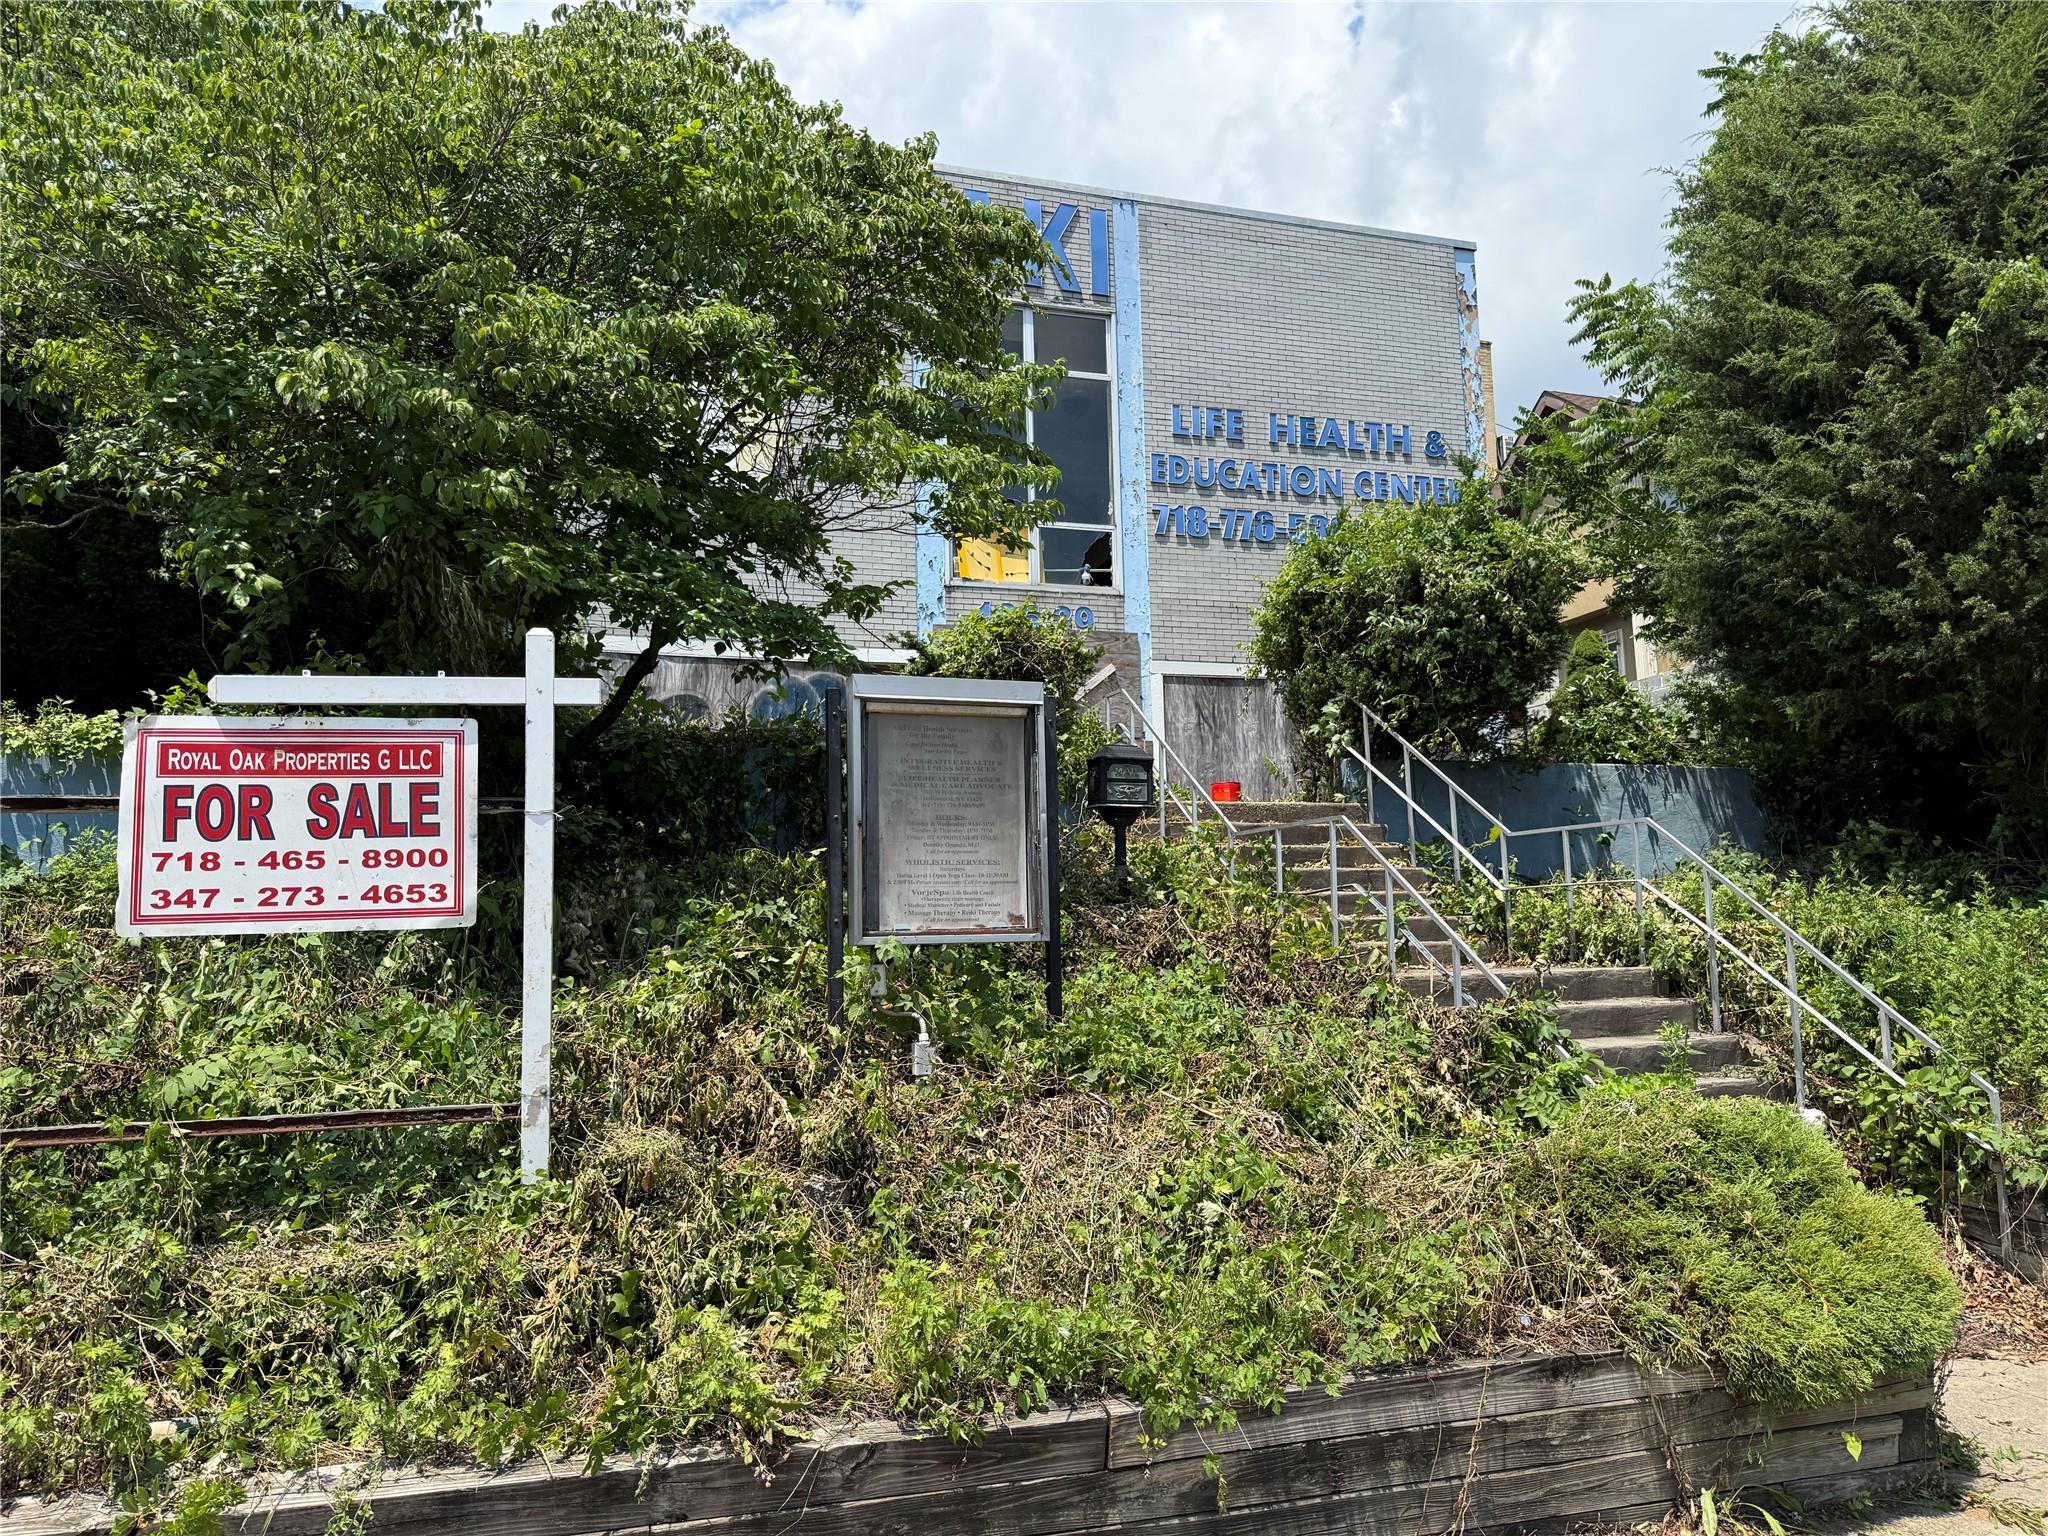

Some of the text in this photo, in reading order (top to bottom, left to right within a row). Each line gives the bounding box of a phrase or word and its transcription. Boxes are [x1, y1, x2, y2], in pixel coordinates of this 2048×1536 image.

[962, 189, 1110, 296] KI
[1171, 404, 1447, 459] LIFE HEALTH &
[1151, 453, 1343, 498] EDUCATION
[168, 749, 432, 770] ROYAL OAK PROPERTIES G LLC
[162, 782, 440, 842] FOR SALE
[152, 852, 221, 872] 718
[257, 850, 326, 870] 465
[361, 849, 448, 868] 8900
[904, 858, 954, 866] WHOLISTIC
[150, 888, 220, 910] 347
[257, 886, 325, 906] 273
[360, 884, 448, 904] 4653
